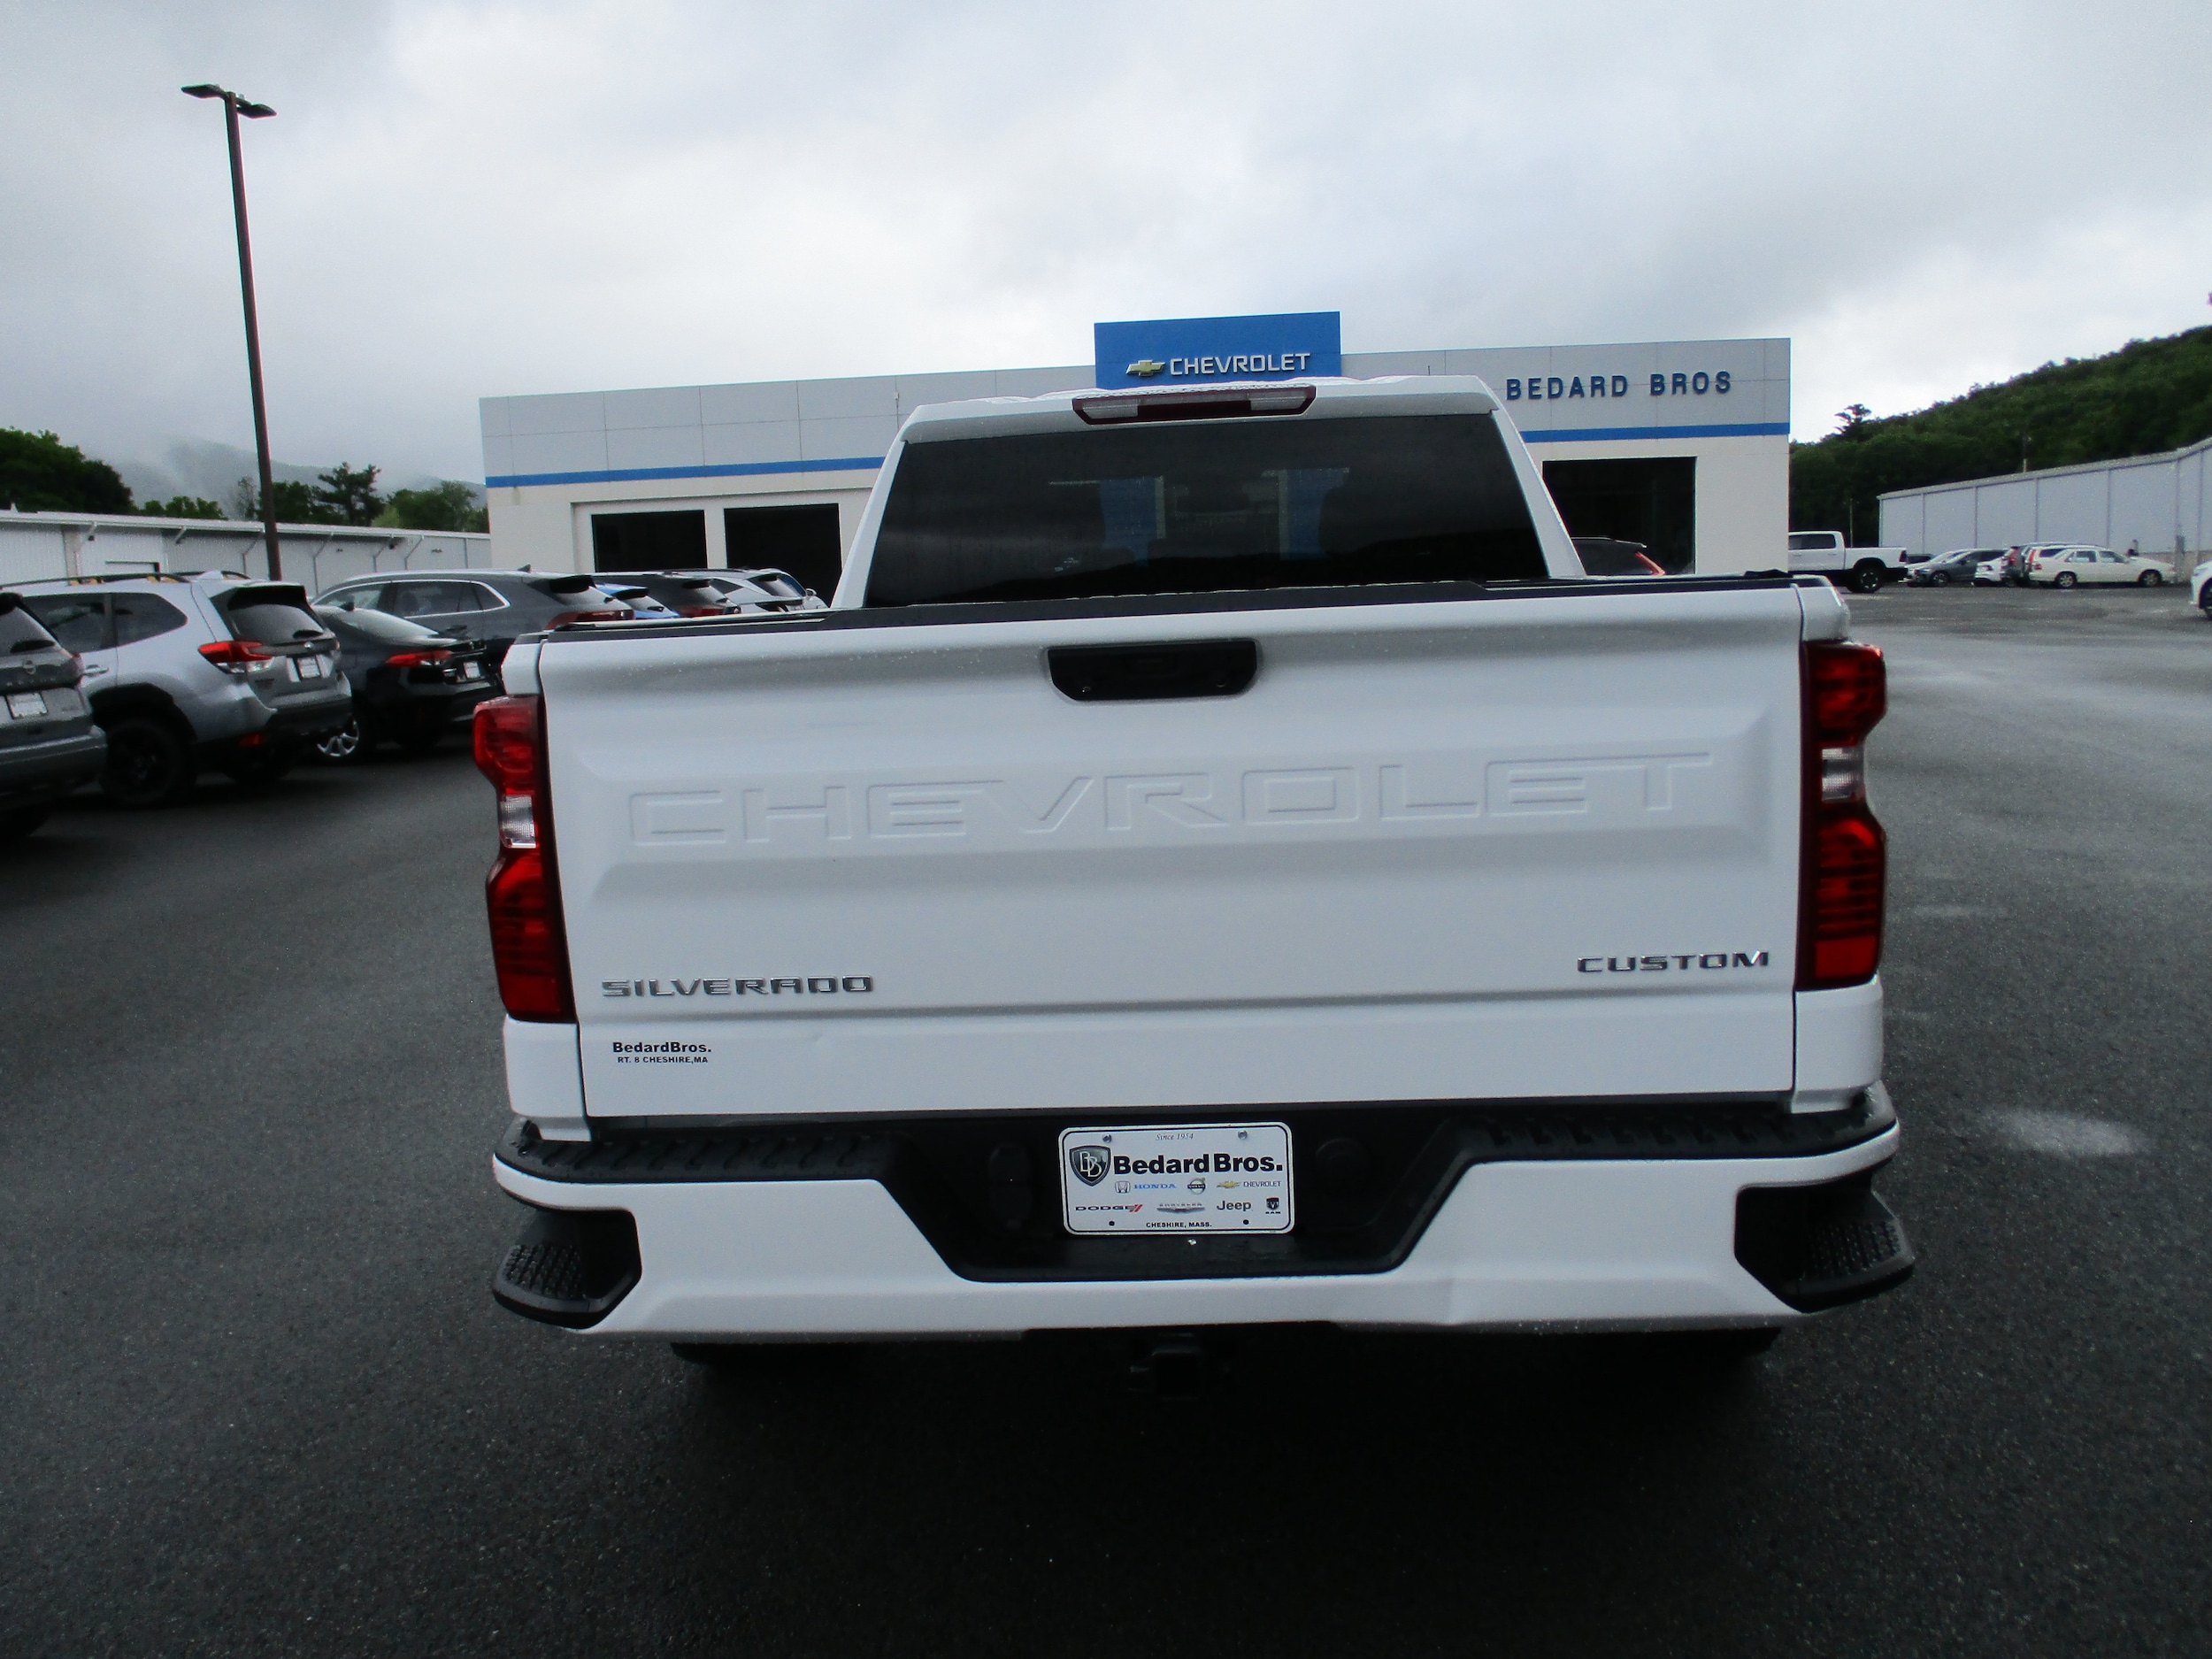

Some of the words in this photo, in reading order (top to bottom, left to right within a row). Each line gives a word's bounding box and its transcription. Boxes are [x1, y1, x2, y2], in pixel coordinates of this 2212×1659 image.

[1170, 352, 1310, 376] CHEVROLET
[1506, 374, 1628, 400] BEDARD
[1650, 371, 1732, 396] BROS
[628, 752, 1713, 846] CHEVROLET
[1577, 949, 1769, 972] CUSTOM
[602, 974, 873, 997] SILVERADO
[1216, 1200, 1252, 1211] Jeep
